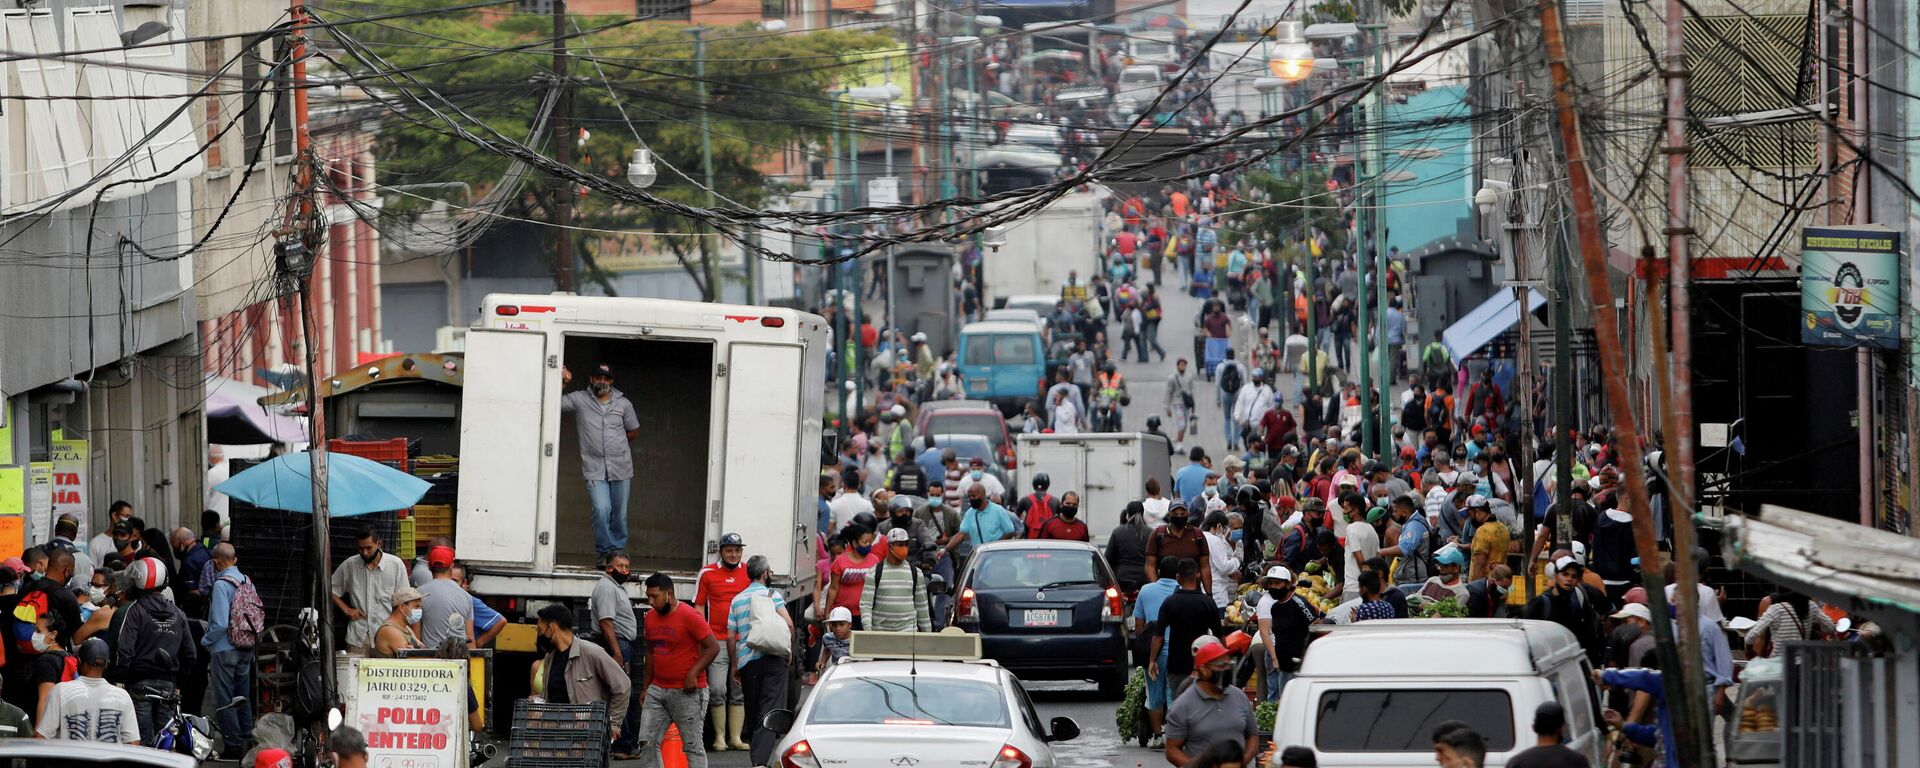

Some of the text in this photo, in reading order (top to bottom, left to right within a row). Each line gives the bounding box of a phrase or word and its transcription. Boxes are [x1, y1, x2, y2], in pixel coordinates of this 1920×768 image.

[1859, 238, 1893, 250] OFICIALES
[366, 668, 454, 679] DISTRIBUIDORA
[366, 682, 452, 694] JAIRU 0329, C.A.
[377, 707, 441, 726] POLLO
[367, 731, 447, 750] ENTERO
